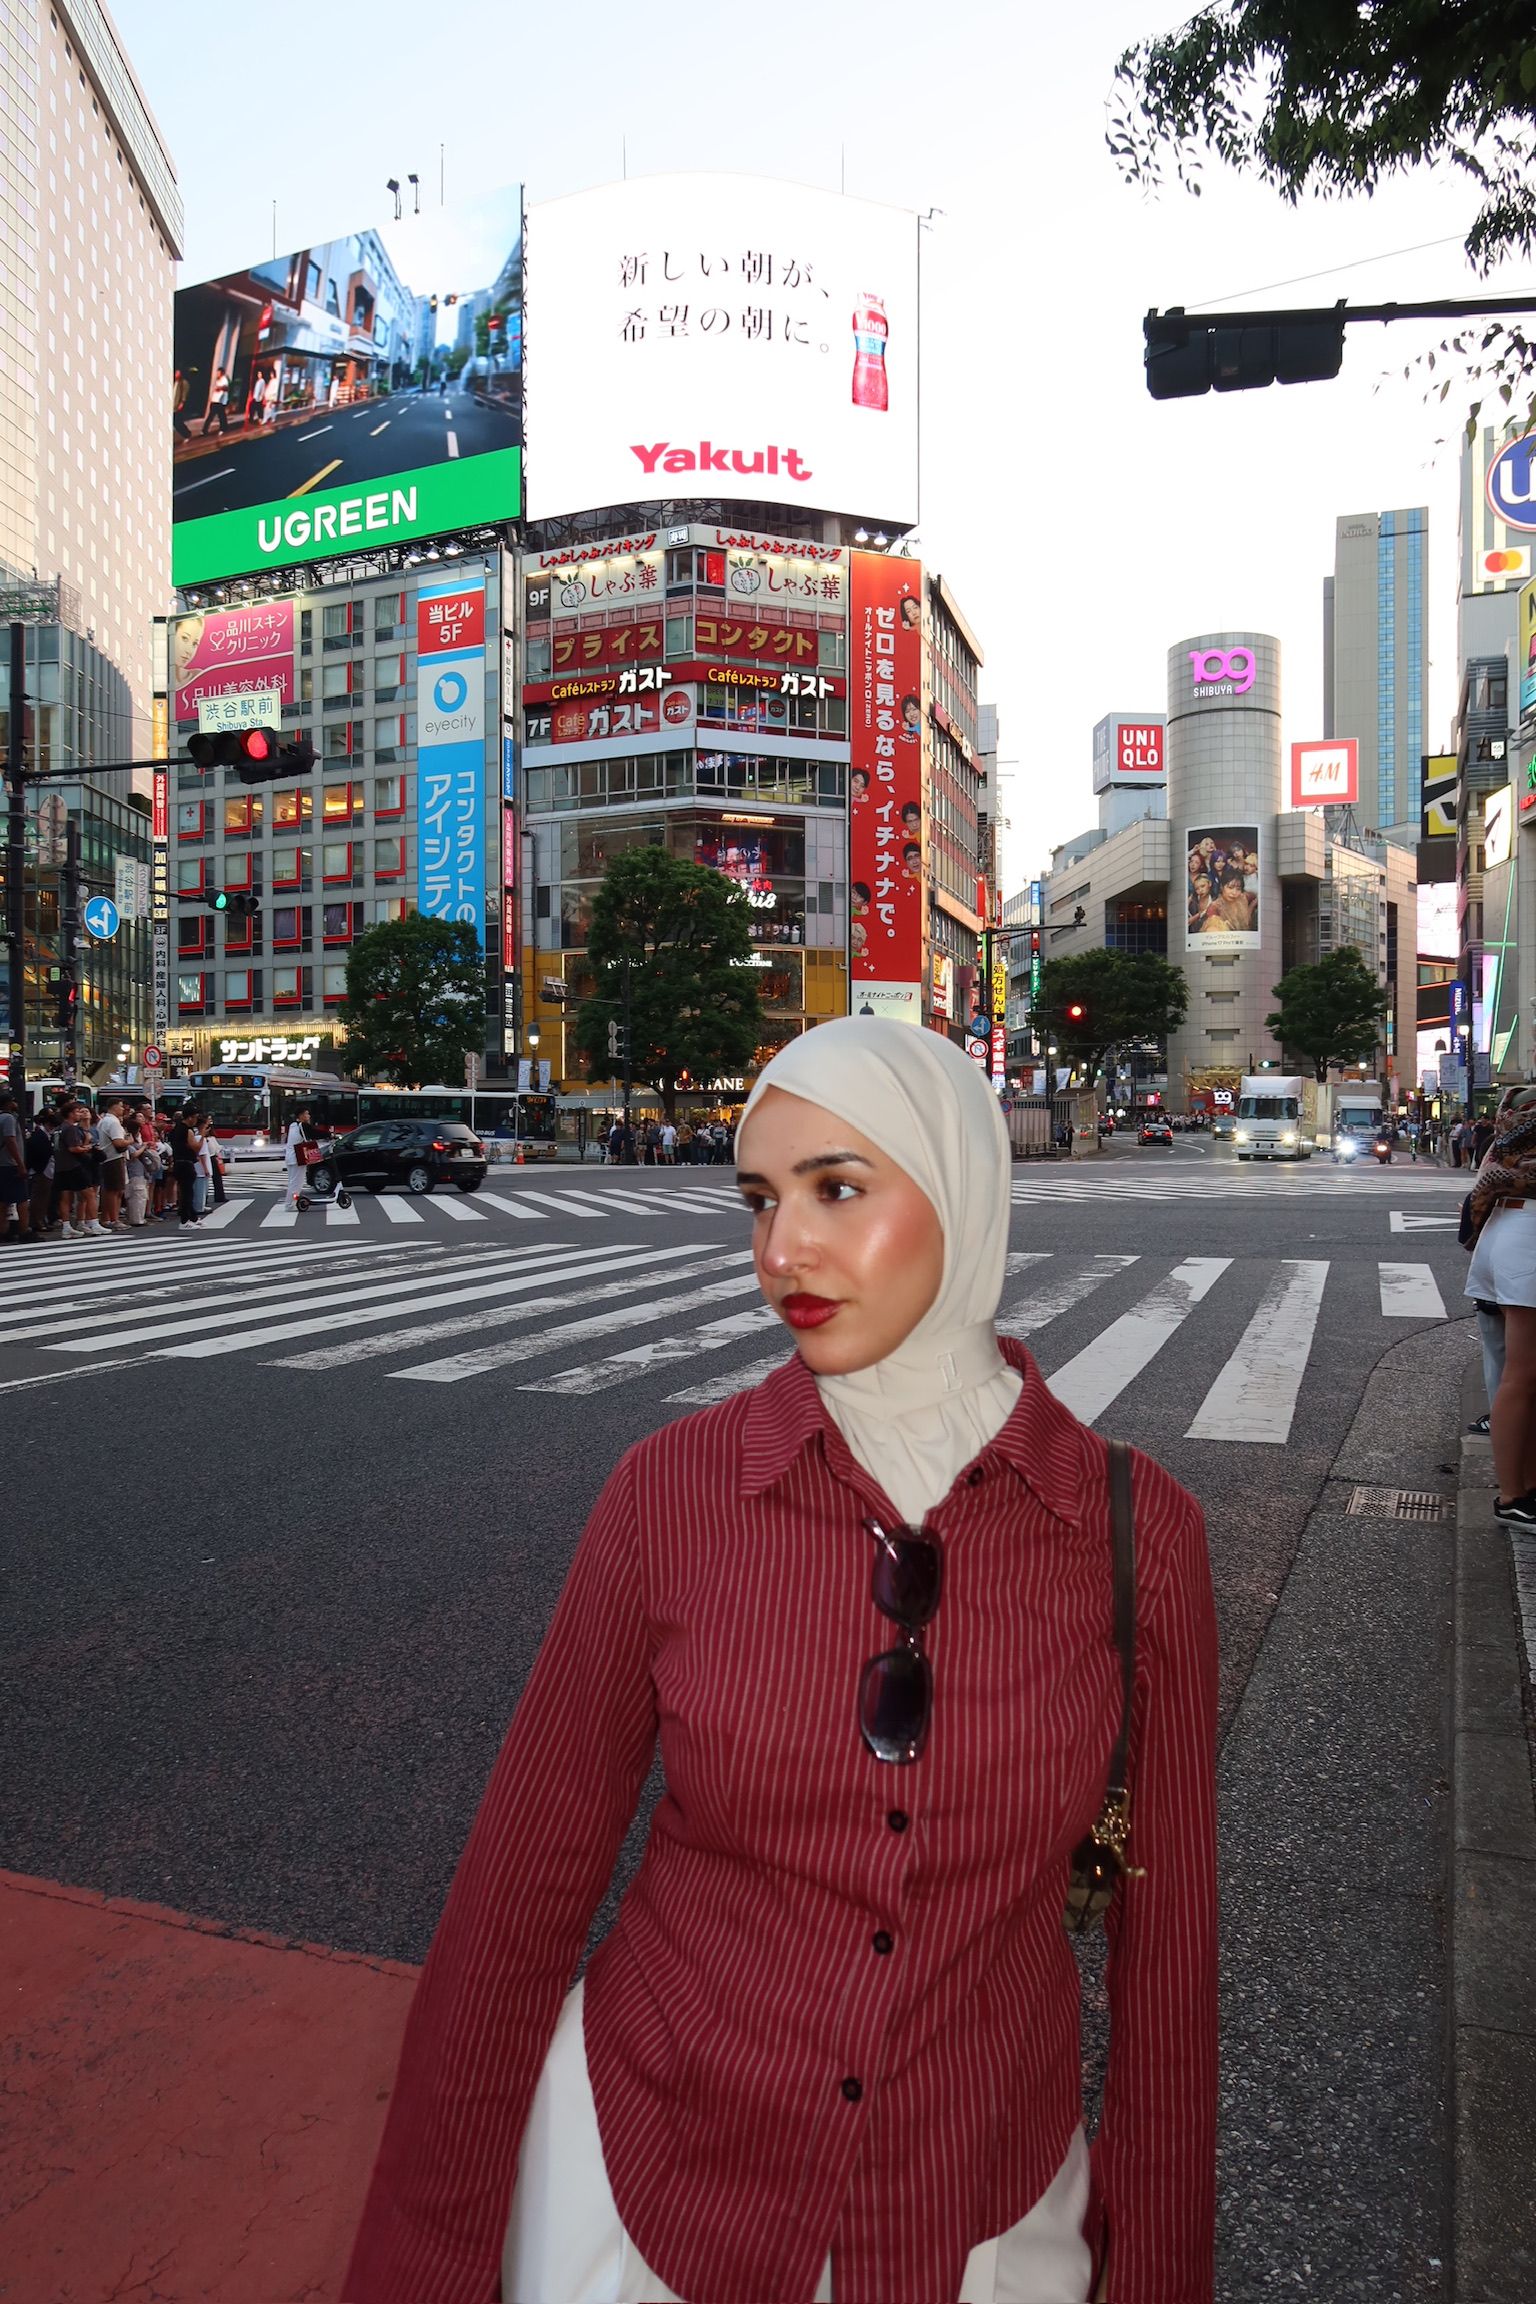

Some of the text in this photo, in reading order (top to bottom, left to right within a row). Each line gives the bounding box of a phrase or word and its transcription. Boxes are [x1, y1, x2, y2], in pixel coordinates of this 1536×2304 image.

[617, 250, 830, 299] 新しい朝が、
[617, 304, 830, 354] 希望の朝に。
[629, 441, 813, 482] Yakult
[258, 486, 417, 553] UGREEN
[539, 533, 657, 568] しゃぶしゃぶバイキング
[716, 530, 842, 561] しゃぶしゃぶバイキング
[591, 564, 658, 597] しゃぶ葉
[769, 567, 840, 600] しゃぶ葉
[529, 588, 549, 606] 9F
[226, 612, 288, 637] 品川スキン
[429, 601, 474, 624] 当ビル
[226, 632, 281, 656] クリニック
[439, 623, 463, 643] 5F
[555, 625, 660, 664] プライス
[696, 621, 814, 656] コンタクト
[619, 666, 672, 694] ガスト
[1188, 646, 1257, 695] 109
[781, 673, 834, 699] ガスト
[1193, 684, 1233, 698] SHIBUYA
[206, 696, 273, 720] 渋谷駅前
[557, 713, 586, 728] Café
[588, 702, 654, 737] ガスト
[666, 705, 689, 716] ガスト
[216, 718, 266, 732] Shibuya Sta.
[425, 715, 477, 736] eyecity
[528, 717, 552, 738] 7F
[1122, 730, 1155, 746] UNI
[1122, 748, 1158, 768] QLO
[875, 607, 896, 938] ゼロを見るなら、イチナナで。
[1309, 762, 1341, 783] H&M
[456, 771, 476, 924] コンタクトの
[155, 908, 167, 918] 5F
[155, 926, 167, 935] 3F
[156, 951, 166, 967] 内科
[993, 965, 1004, 1005] 処方せん
[182, 1041, 194, 1051] 2F
[220, 1036, 321, 1063] サンドラッグ
